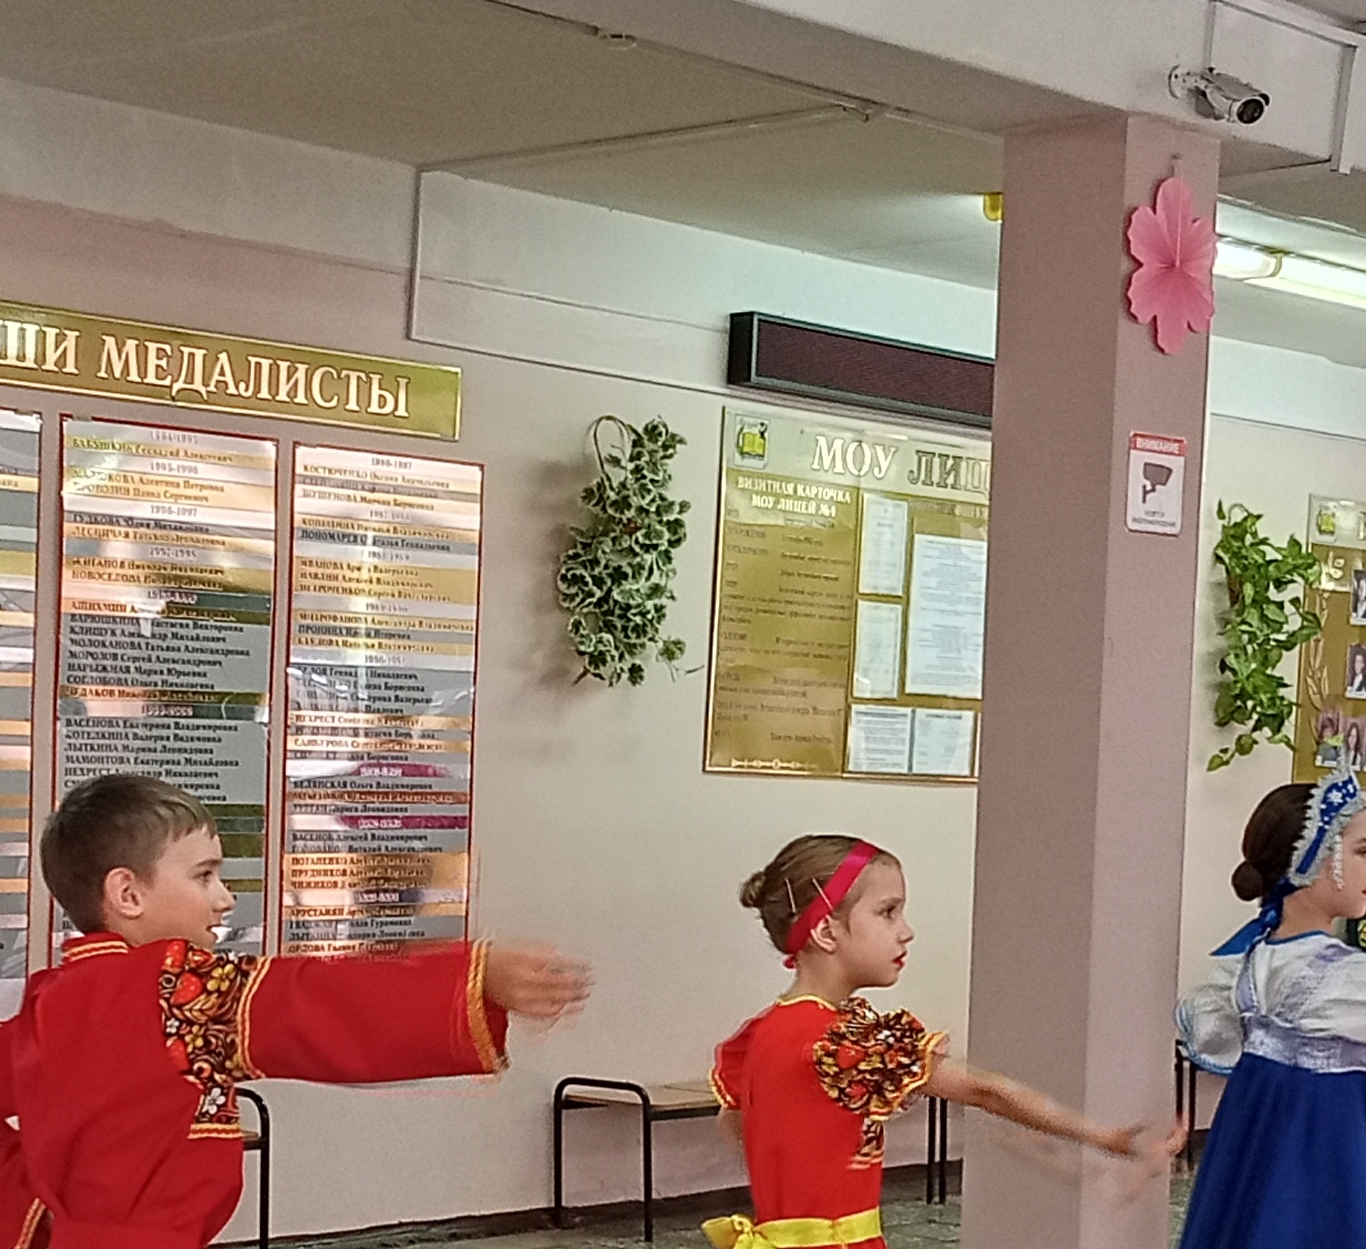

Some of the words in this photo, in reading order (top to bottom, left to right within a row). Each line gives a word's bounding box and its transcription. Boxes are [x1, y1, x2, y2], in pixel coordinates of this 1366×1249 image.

[97, 333, 410, 418] МЕДАЛИСТЫ
[811, 435, 897, 480] МОУ
[737, 476, 794, 496] ВИЗИТНАЯ
[796, 482, 852, 505] КАРТОЧКА
[751, 494, 775, 508] МОУ
[777, 498, 816, 515] ЛИЦЕЙ
